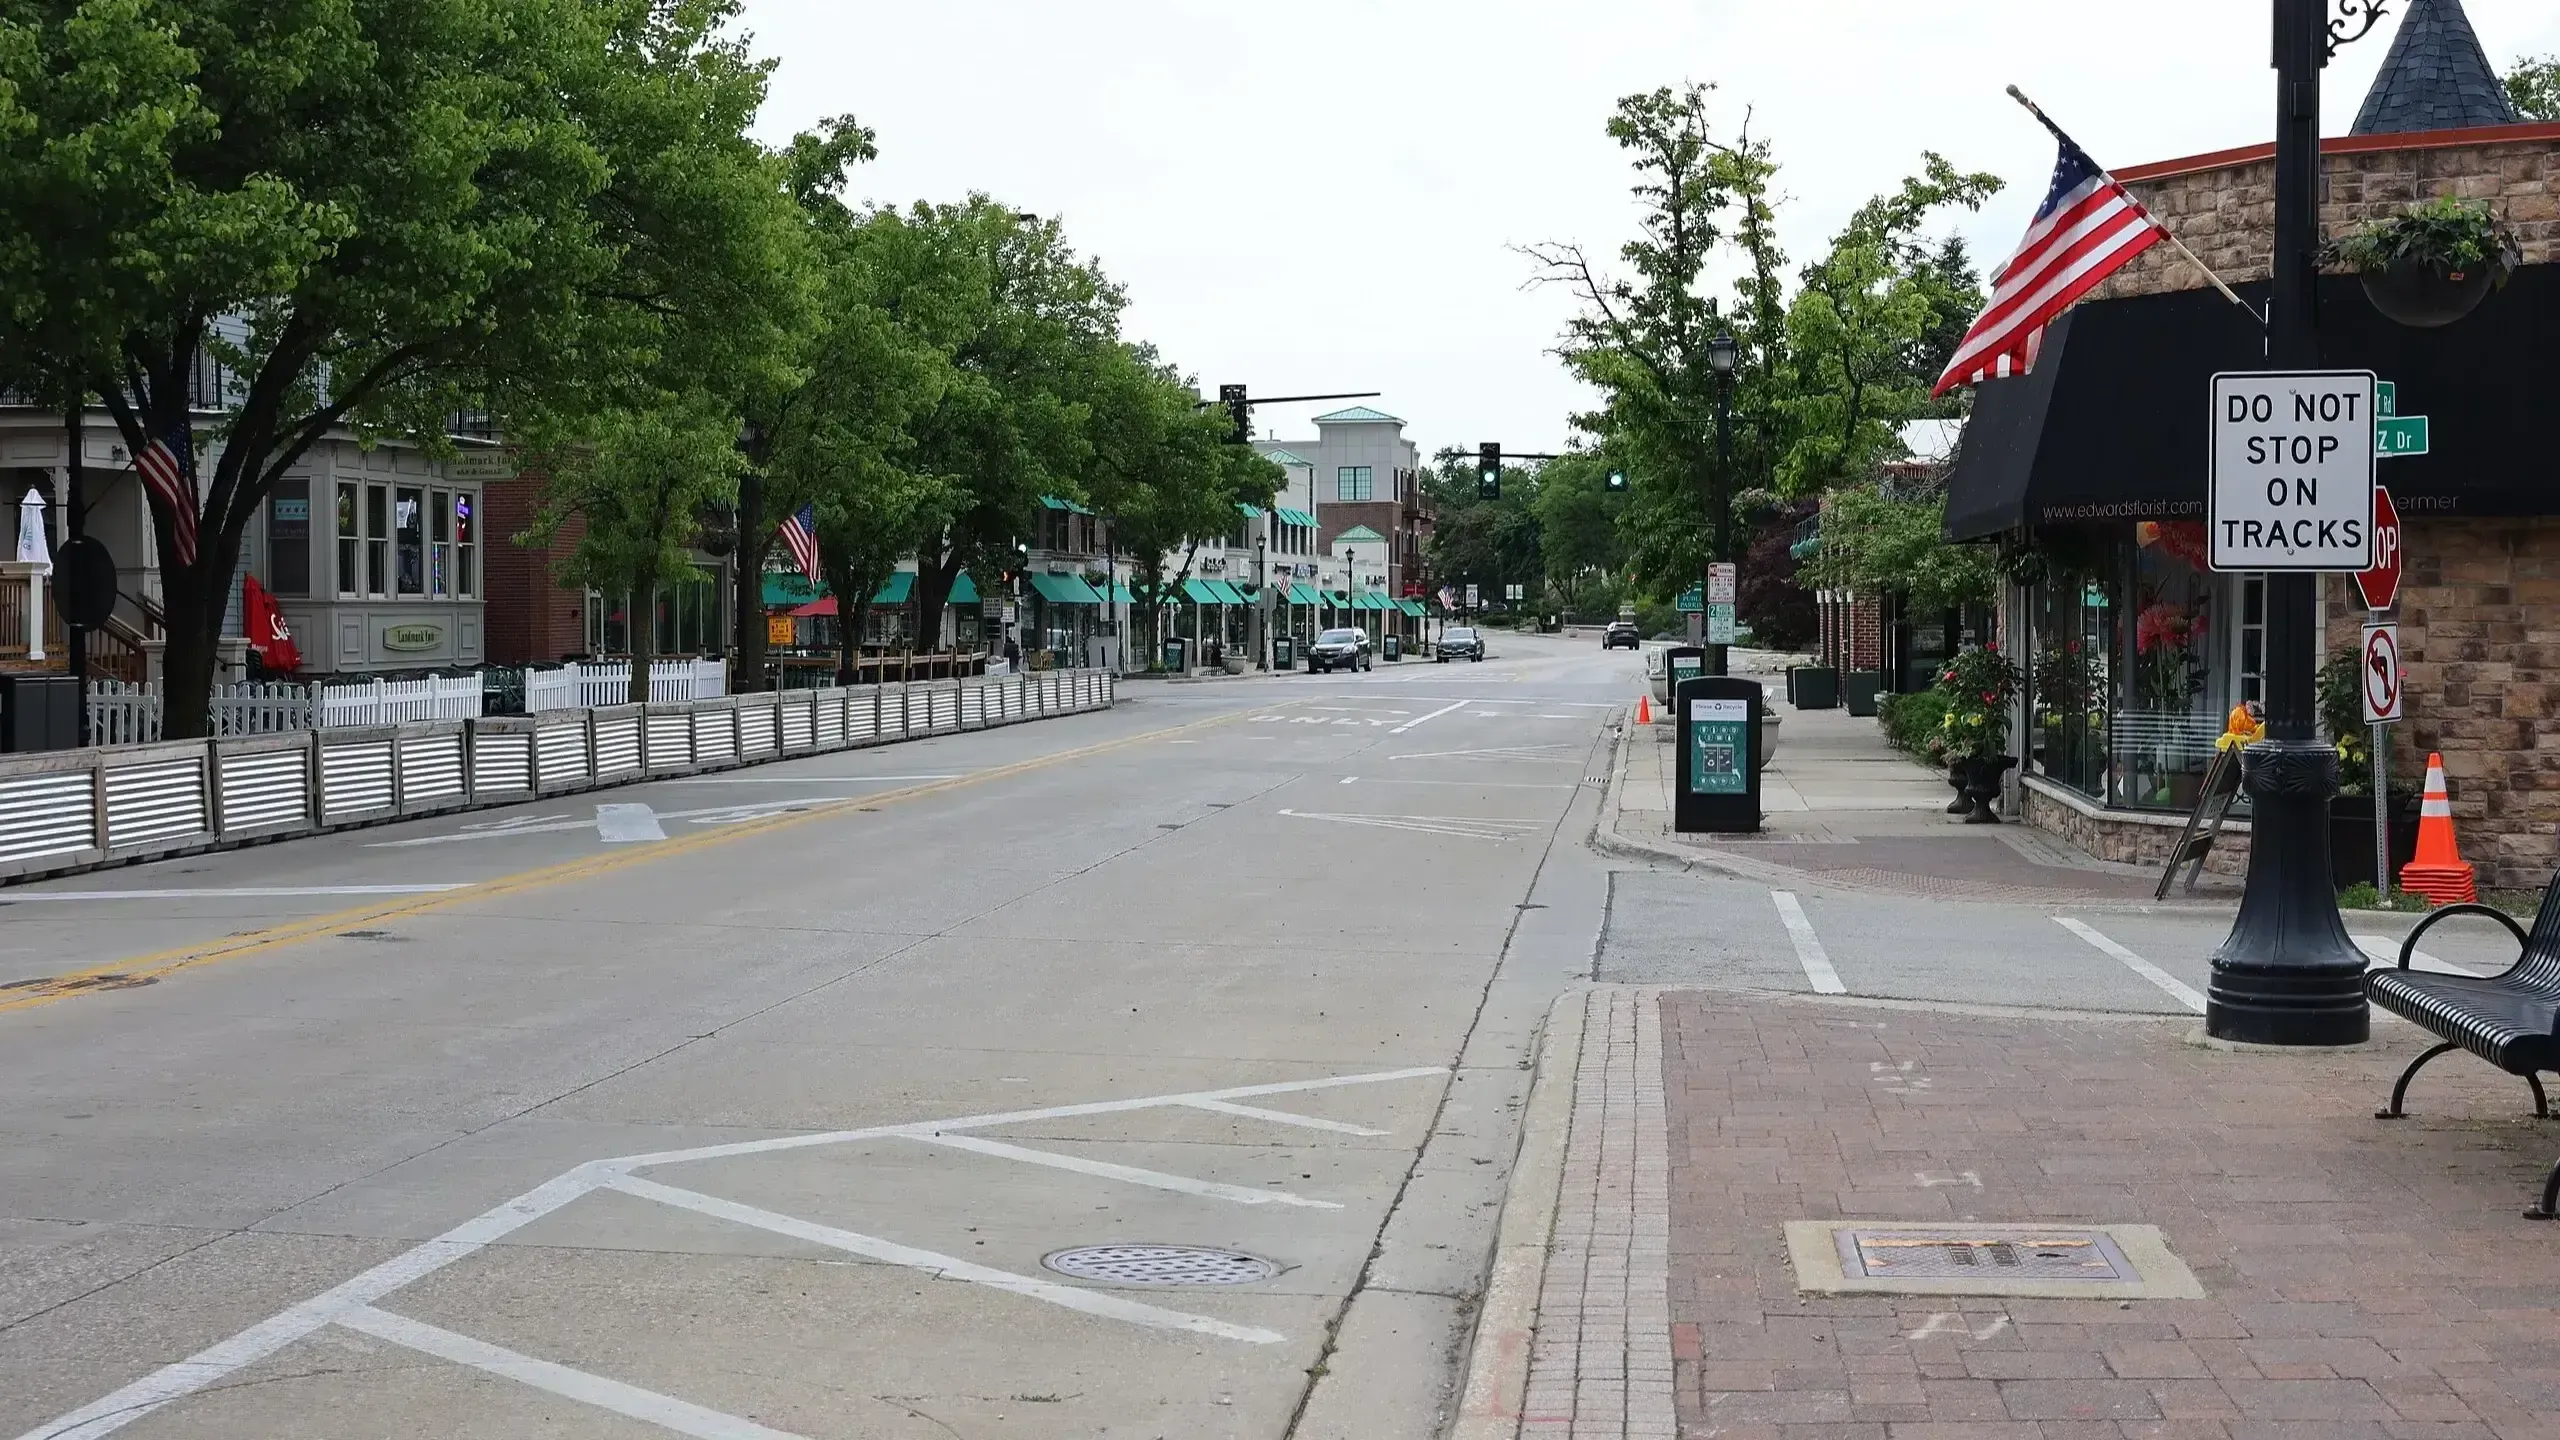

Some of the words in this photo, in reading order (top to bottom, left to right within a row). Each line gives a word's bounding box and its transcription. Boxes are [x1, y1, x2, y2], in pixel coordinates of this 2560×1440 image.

[2228, 394, 2273, 423] DO
[2294, 393, 2361, 422] NOT
[2383, 395, 2392, 414] Rd
[2246, 435, 2339, 465] STOP
[2397, 431, 2412, 449] Dr
[2267, 478, 2317, 506] ON
[2391, 495, 2460, 510] ermer
[2043, 498, 2203, 518] www.edwardsflorist.com
[2222, 519, 2362, 549] TRACKS
[2376, 526, 2397, 569] OP
[1247, 715, 1404, 726] ONLY
